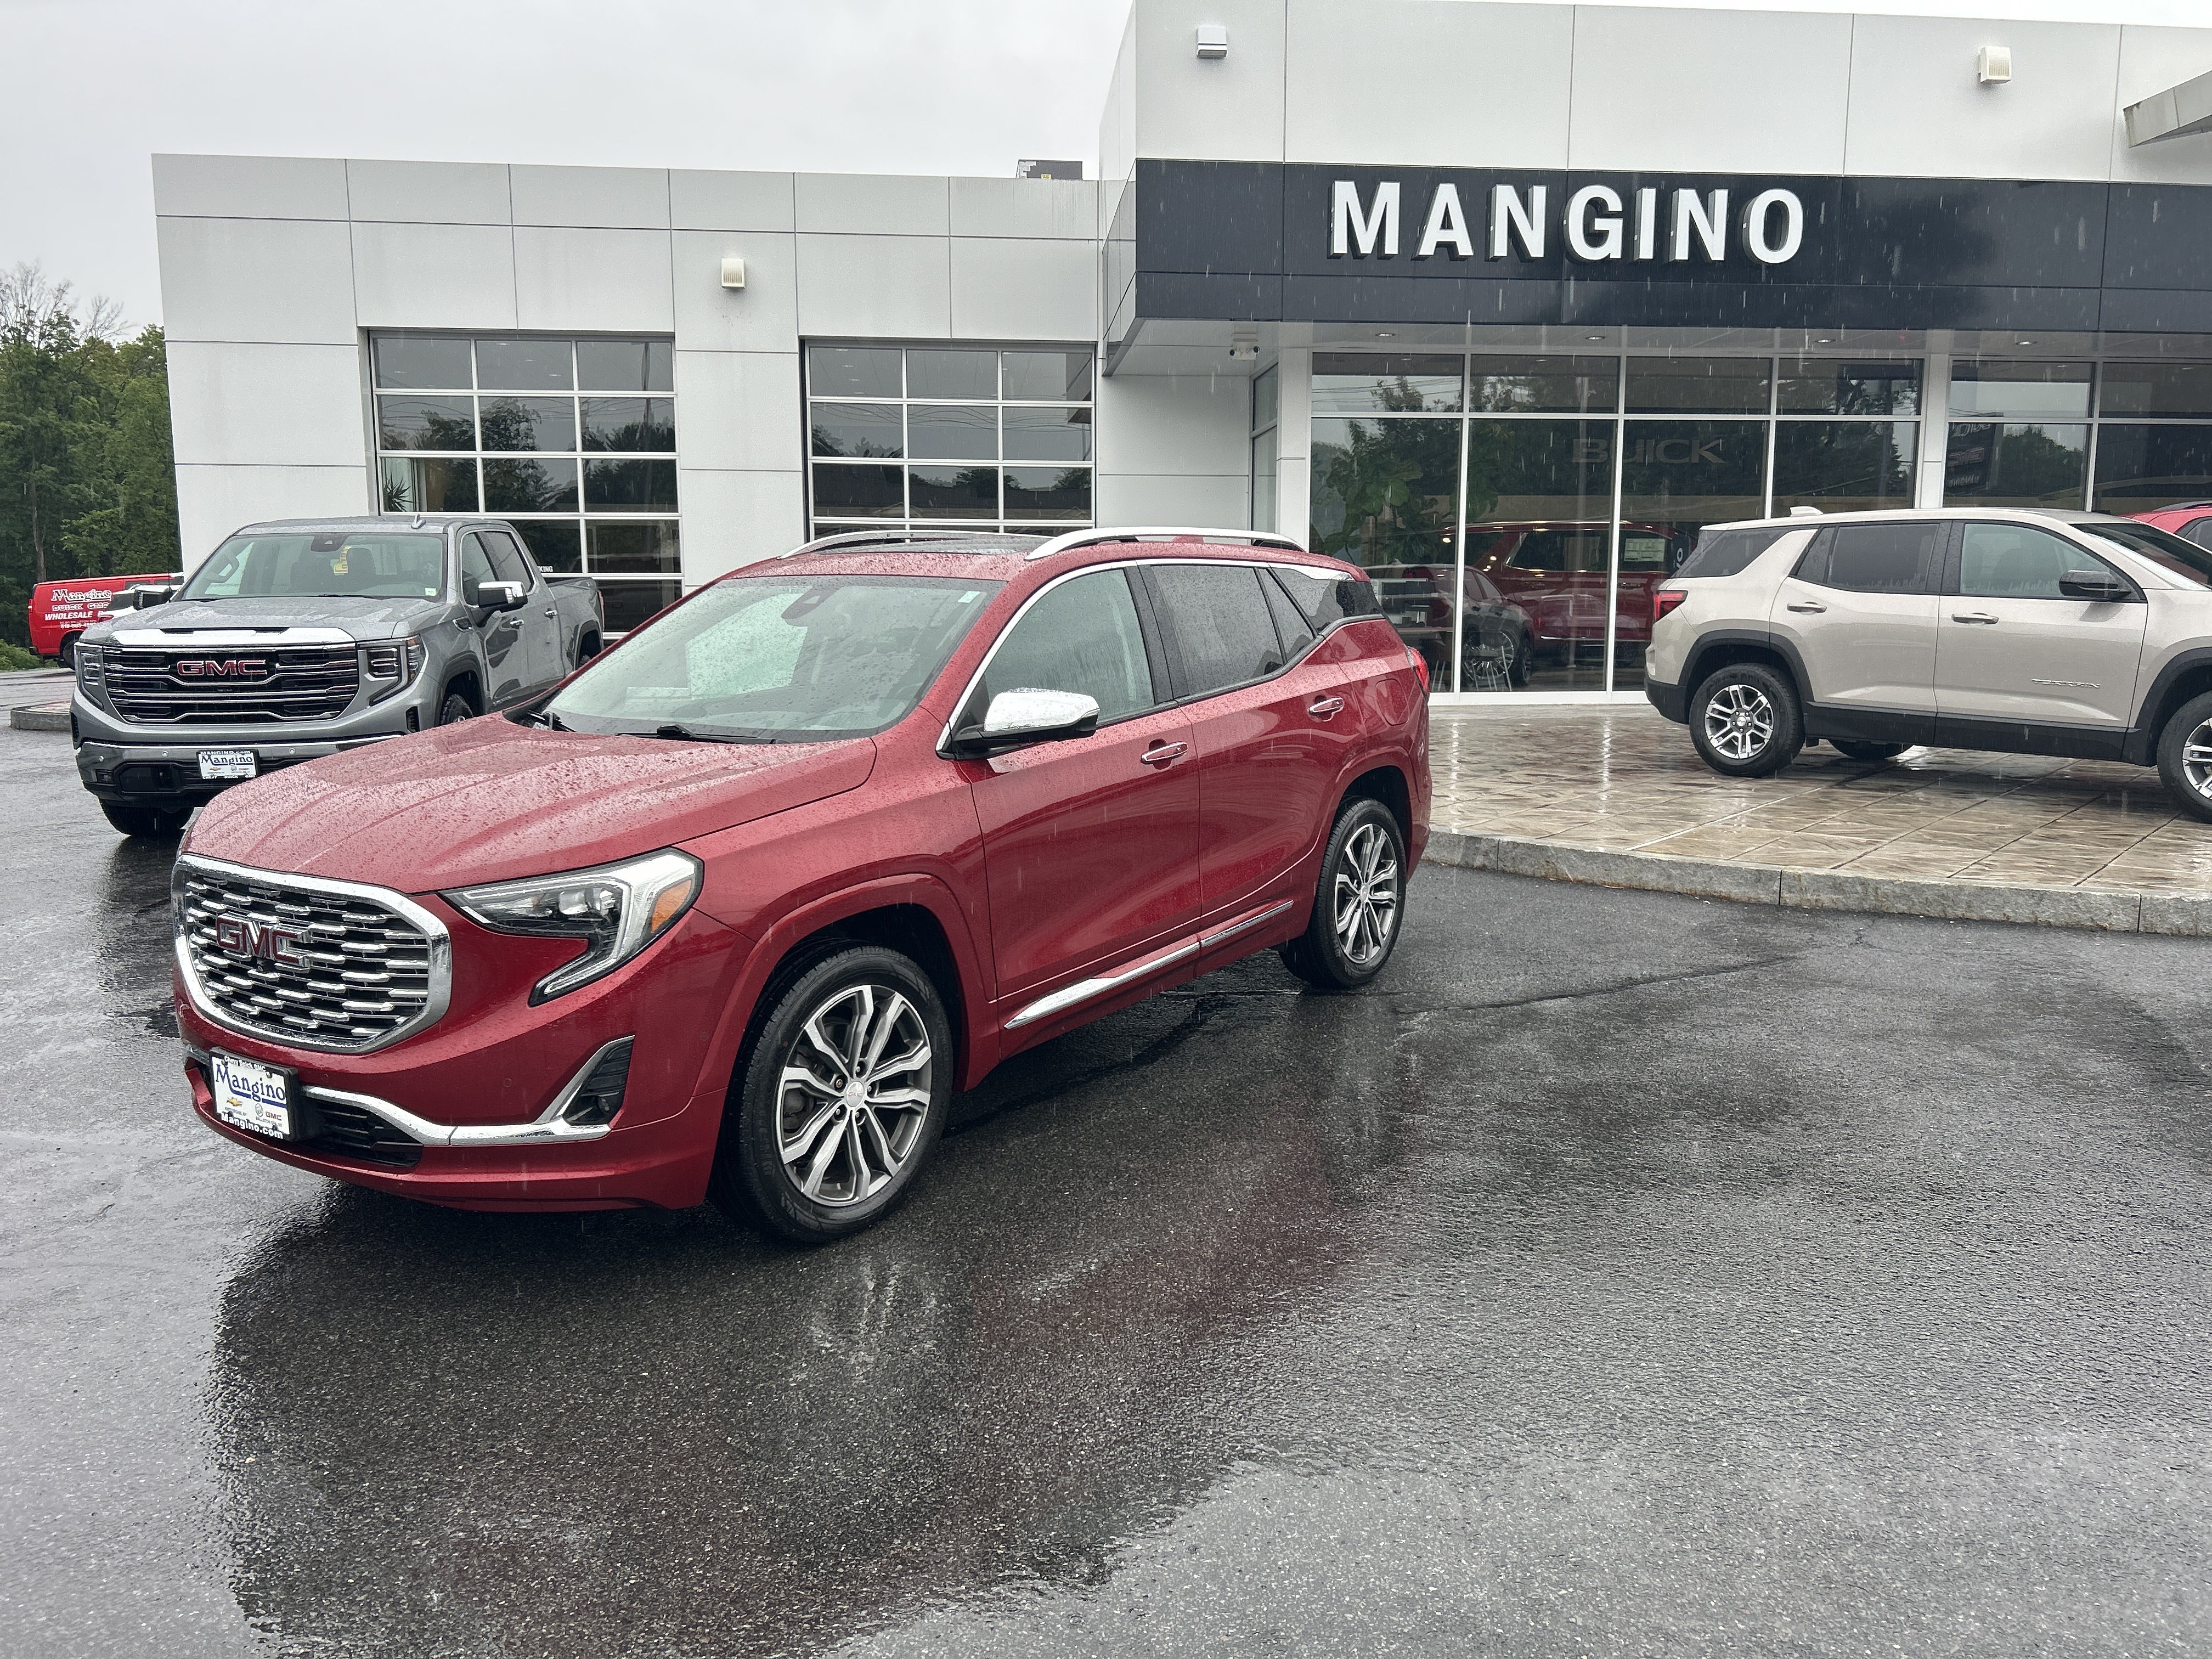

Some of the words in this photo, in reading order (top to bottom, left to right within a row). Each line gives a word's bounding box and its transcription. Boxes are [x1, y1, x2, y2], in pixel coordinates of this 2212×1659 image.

[1330, 180, 1804, 264] MANGINO
[1572, 439, 1727, 463] BUICK
[50, 589, 112, 603] Mangino
[44, 611, 93, 620] WHOLESALE
[177, 659, 267, 676] GMC
[201, 754, 254, 766] Mangino
[216, 914, 307, 968] GMC
[216, 1063, 287, 1106] Mangino
[221, 1111, 284, 1139] Mangino.com
[265, 1111, 283, 1121] GMC
